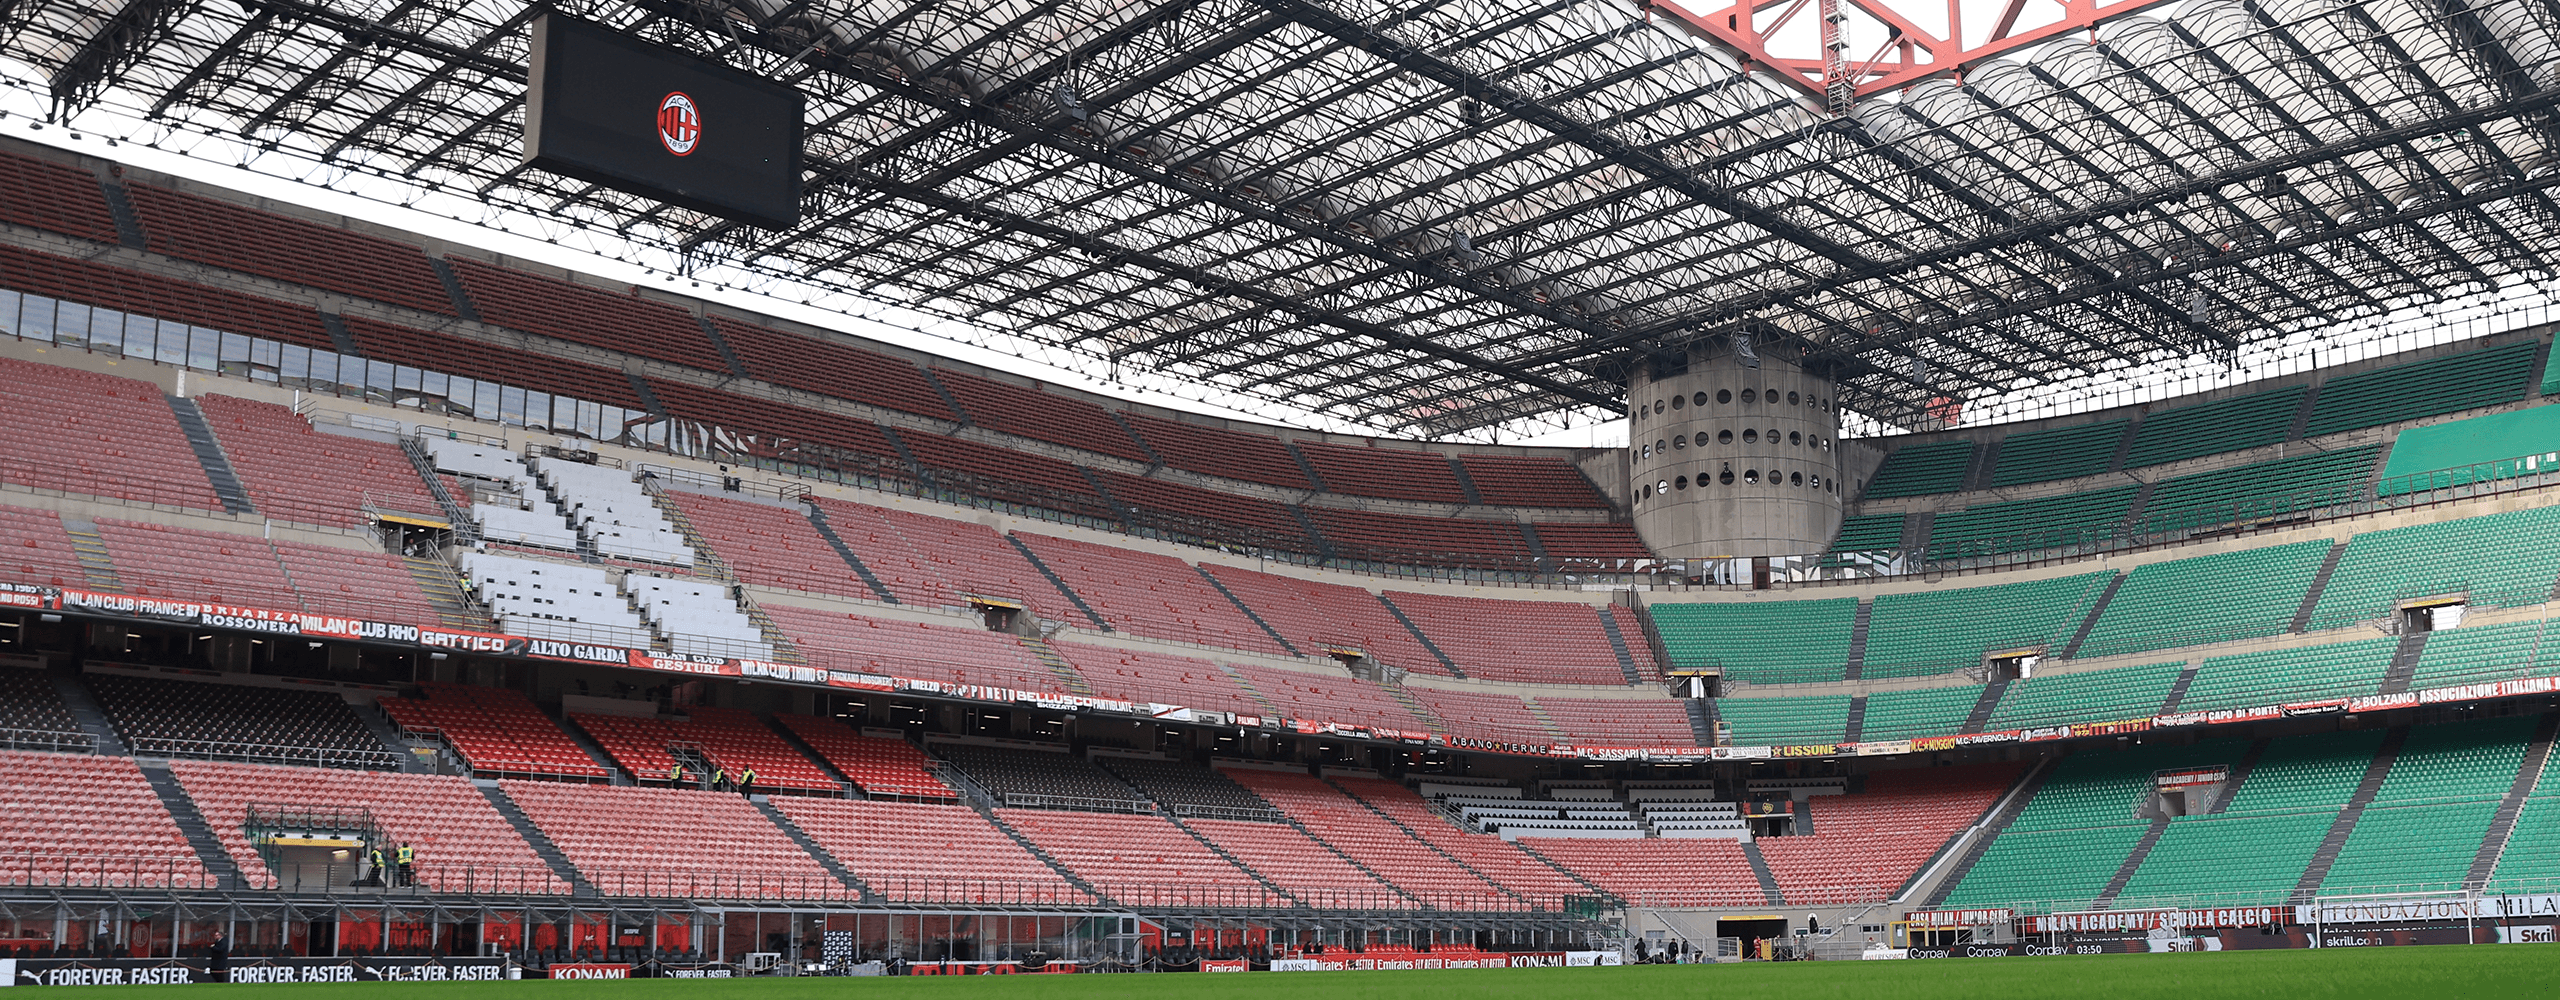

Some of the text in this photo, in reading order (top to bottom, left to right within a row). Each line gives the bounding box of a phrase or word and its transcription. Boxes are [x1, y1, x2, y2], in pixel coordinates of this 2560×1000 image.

[669, 98, 692, 112] ACM
[669, 139, 688, 149] 1899
[14, 594, 39, 605] ROSSI
[64, 591, 200, 617] MILAN CLUB FRANCE 57
[202, 604, 300, 622] BRIANZA
[202, 614, 299, 634] ROSSONERA
[301, 615, 418, 641] MILAN CLUB RHO
[421, 631, 505, 651] GATTICO
[529, 640, 627, 663] ALTO GARDA
[647, 650, 724, 665] MILAN CLUB
[653, 659, 720, 674] GESTURI
[740, 660, 769, 676] MILAN
[769, 663, 790, 679] CLUB
[911, 679, 940, 692] MELZO
[971, 684, 1015, 701] PINETO
[2419, 682, 2499, 703] ASSOCIAZIONE
[2501, 677, 2551, 694] ITALIANA
[1016, 690, 1092, 707] BELLUSCO
[1093, 698, 1133, 713] PANTIGLIATE
[2363, 692, 2416, 708] BOLZANO
[1037, 703, 1078, 711] SKIZZATO
[2208, 705, 2279, 720] CAPO DI PONTE
[1451, 736, 1493, 749] ABANO
[1503, 742, 1546, 754] TERME
[1972, 733, 2011, 744] TAVERNOLA
[1577, 747, 1596, 758] M.C.
[1599, 748, 1639, 758] SASSARI
[1783, 745, 1836, 757] LISSONE
[2332, 900, 2484, 920] FONDAZIONE
[1910, 913, 1929, 927] CASA
[1931, 911, 1954, 926] MILAN
[1961, 909, 1988, 925] JUNIOR
[1989, 909, 2009, 924] CLUB
[2036, 916, 2077, 931] MILAN
[2081, 913, 2145, 930] ACADEMY
[2160, 911, 2214, 928] SCUOLA
[2218, 909, 2271, 925] CALCIO
[1910, 948, 1950, 959] Corpay
[1966, 946, 2008, 958] Corpay
[2077, 945, 2102, 954] 03:50
[1290, 962, 1308, 971] MSC
[1377, 958, 1413, 970] Emirates
[1444, 957, 1479, 969] Emirates
[1511, 955, 1563, 967] KONAMI
[1604, 956, 1618, 964] MSC
[230, 966, 358, 984] FOREVER. FASTER.
[453, 965, 503, 981] FASTER.
[554, 967, 626, 979] KONAMI
[1205, 964, 1244, 972] Emirates
[50, 966, 194, 986] FOREVER. FASTER.
